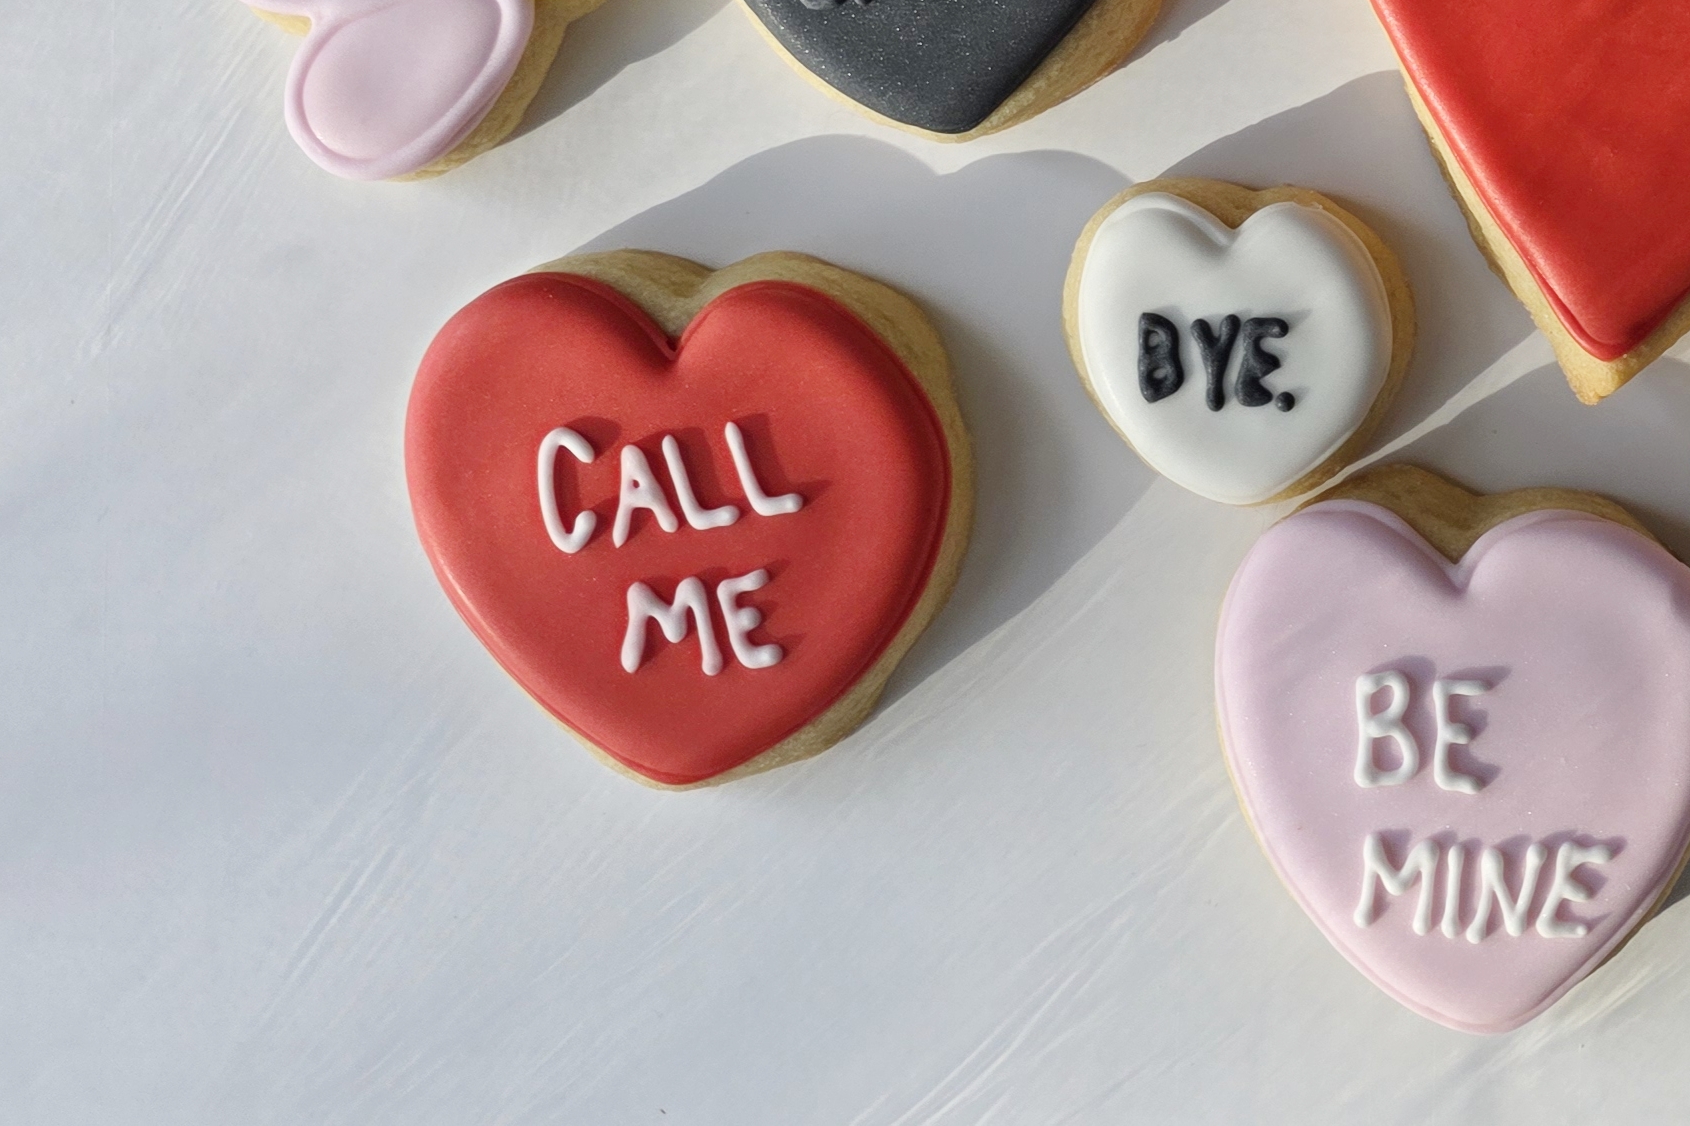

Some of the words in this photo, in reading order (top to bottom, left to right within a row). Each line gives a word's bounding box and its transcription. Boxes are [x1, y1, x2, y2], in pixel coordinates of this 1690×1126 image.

[1137, 312, 1295, 412] BYE.
[537, 421, 804, 554] CALL
[620, 568, 783, 677] ME
[1354, 671, 1492, 794] BE
[1353, 833, 1615, 944] MINE
